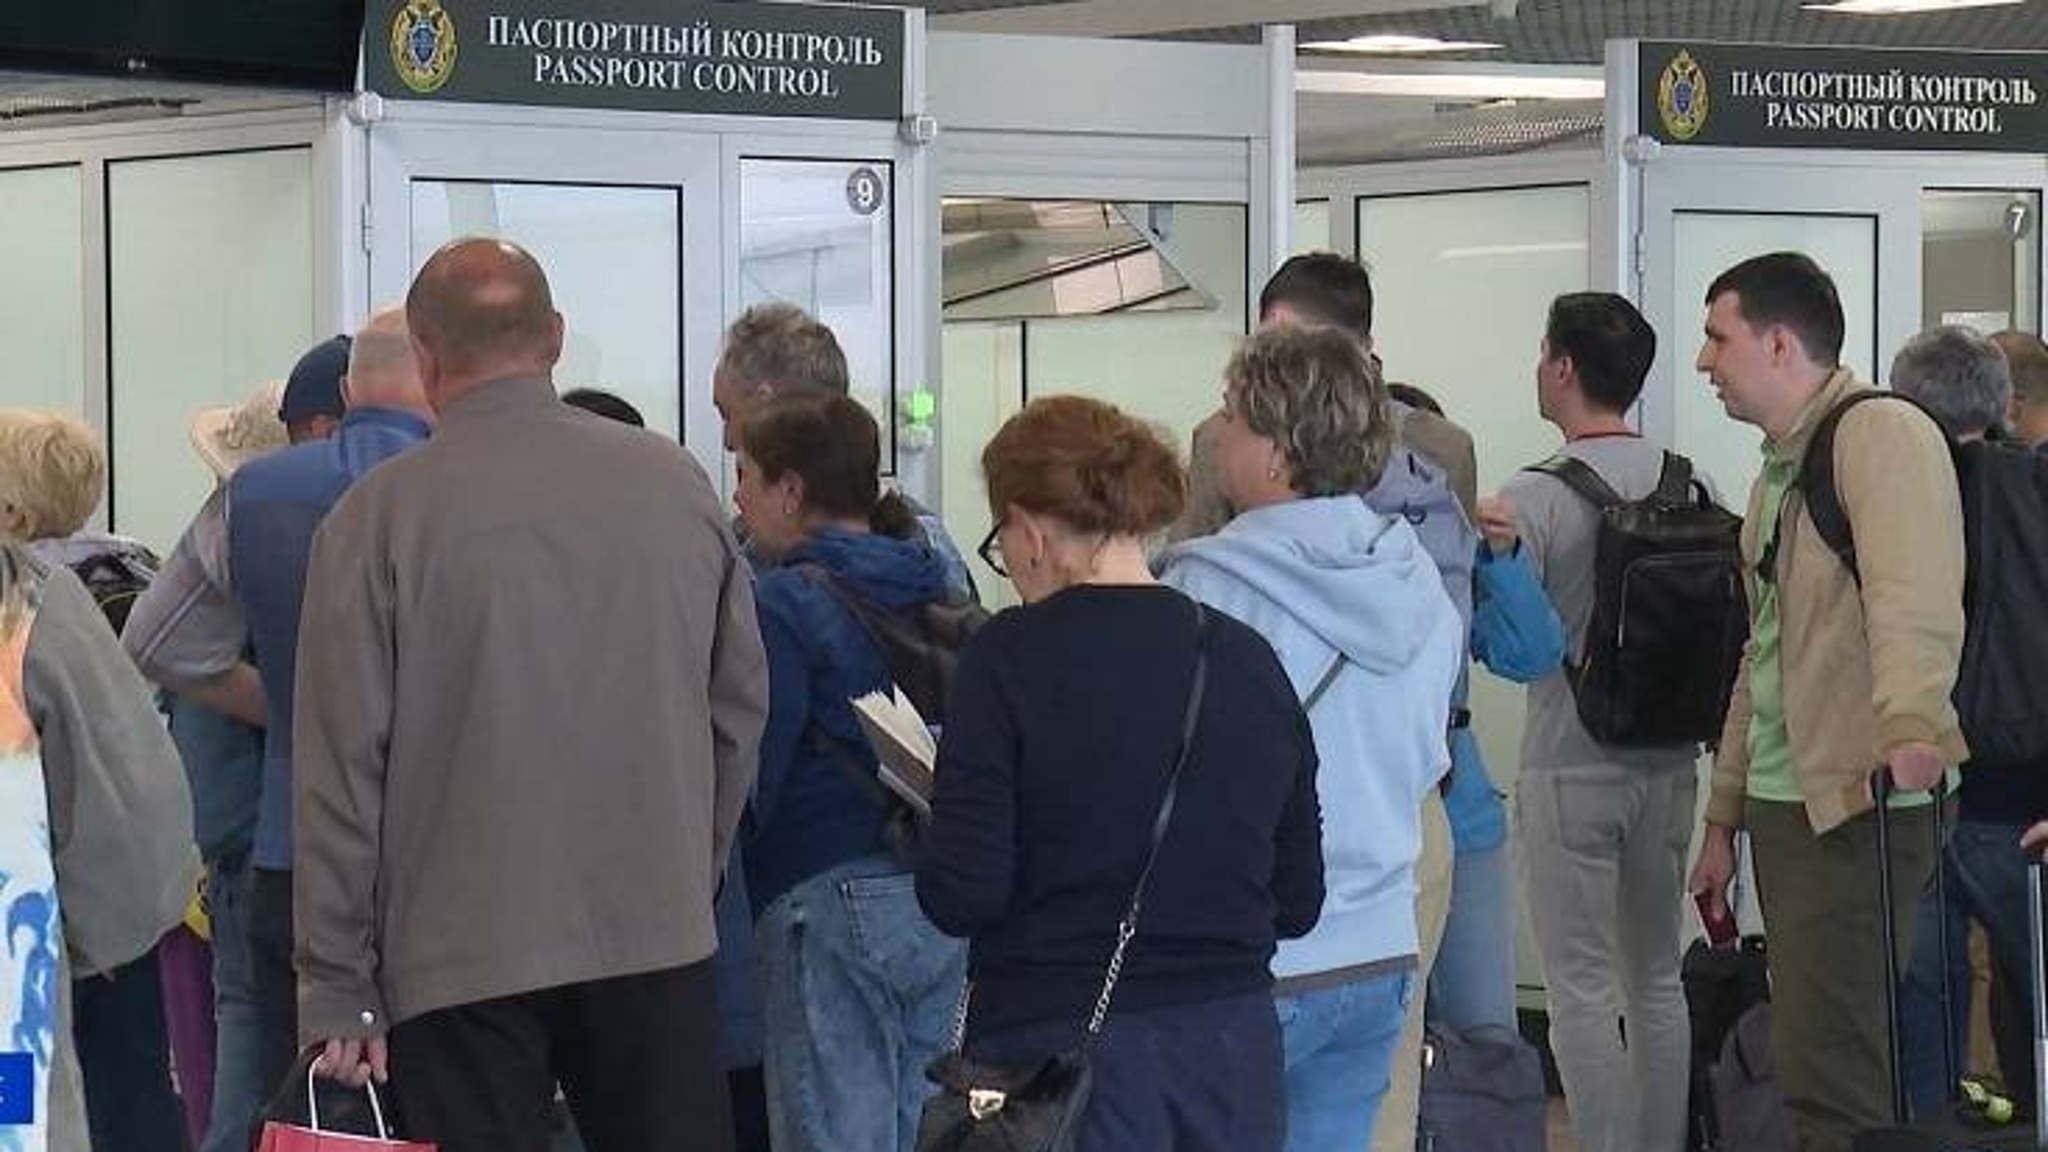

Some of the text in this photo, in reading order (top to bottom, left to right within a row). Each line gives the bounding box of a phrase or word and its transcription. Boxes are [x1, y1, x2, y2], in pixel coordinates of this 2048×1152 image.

[488, 15, 882, 66] ПАСПОРТНЫЙ КОНТРОЛЬ
[534, 55, 839, 98] PASSPORT CONTROL
[1731, 68, 2035, 105] ПАСПОРТНЫЙ КОНТРОЛЬ
[1766, 102, 2002, 133] PASSPORT CONTROL
[856, 177, 874, 205] 9
[2010, 206, 2027, 234] 7
